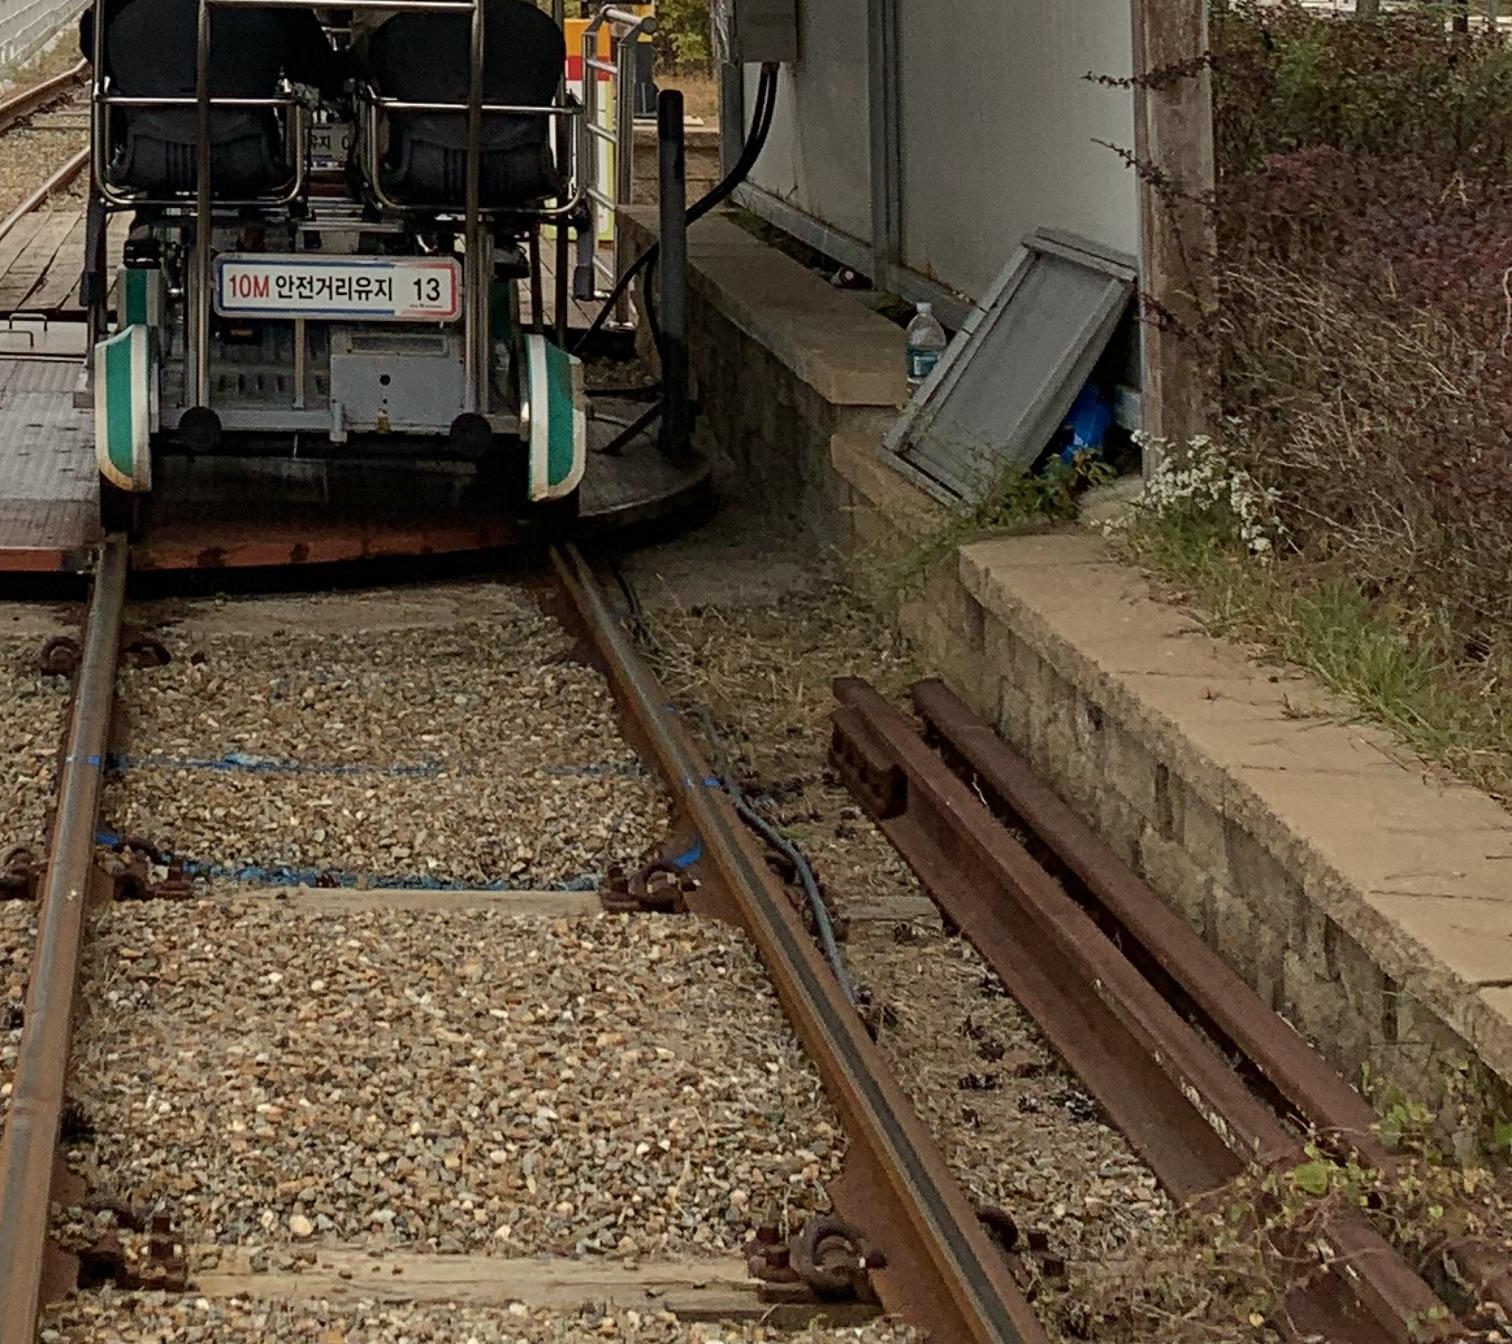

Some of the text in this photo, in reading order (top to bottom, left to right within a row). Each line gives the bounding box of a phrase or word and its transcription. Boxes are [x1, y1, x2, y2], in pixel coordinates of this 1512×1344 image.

[228, 273, 441, 301] 10M 안전거리유지 13
